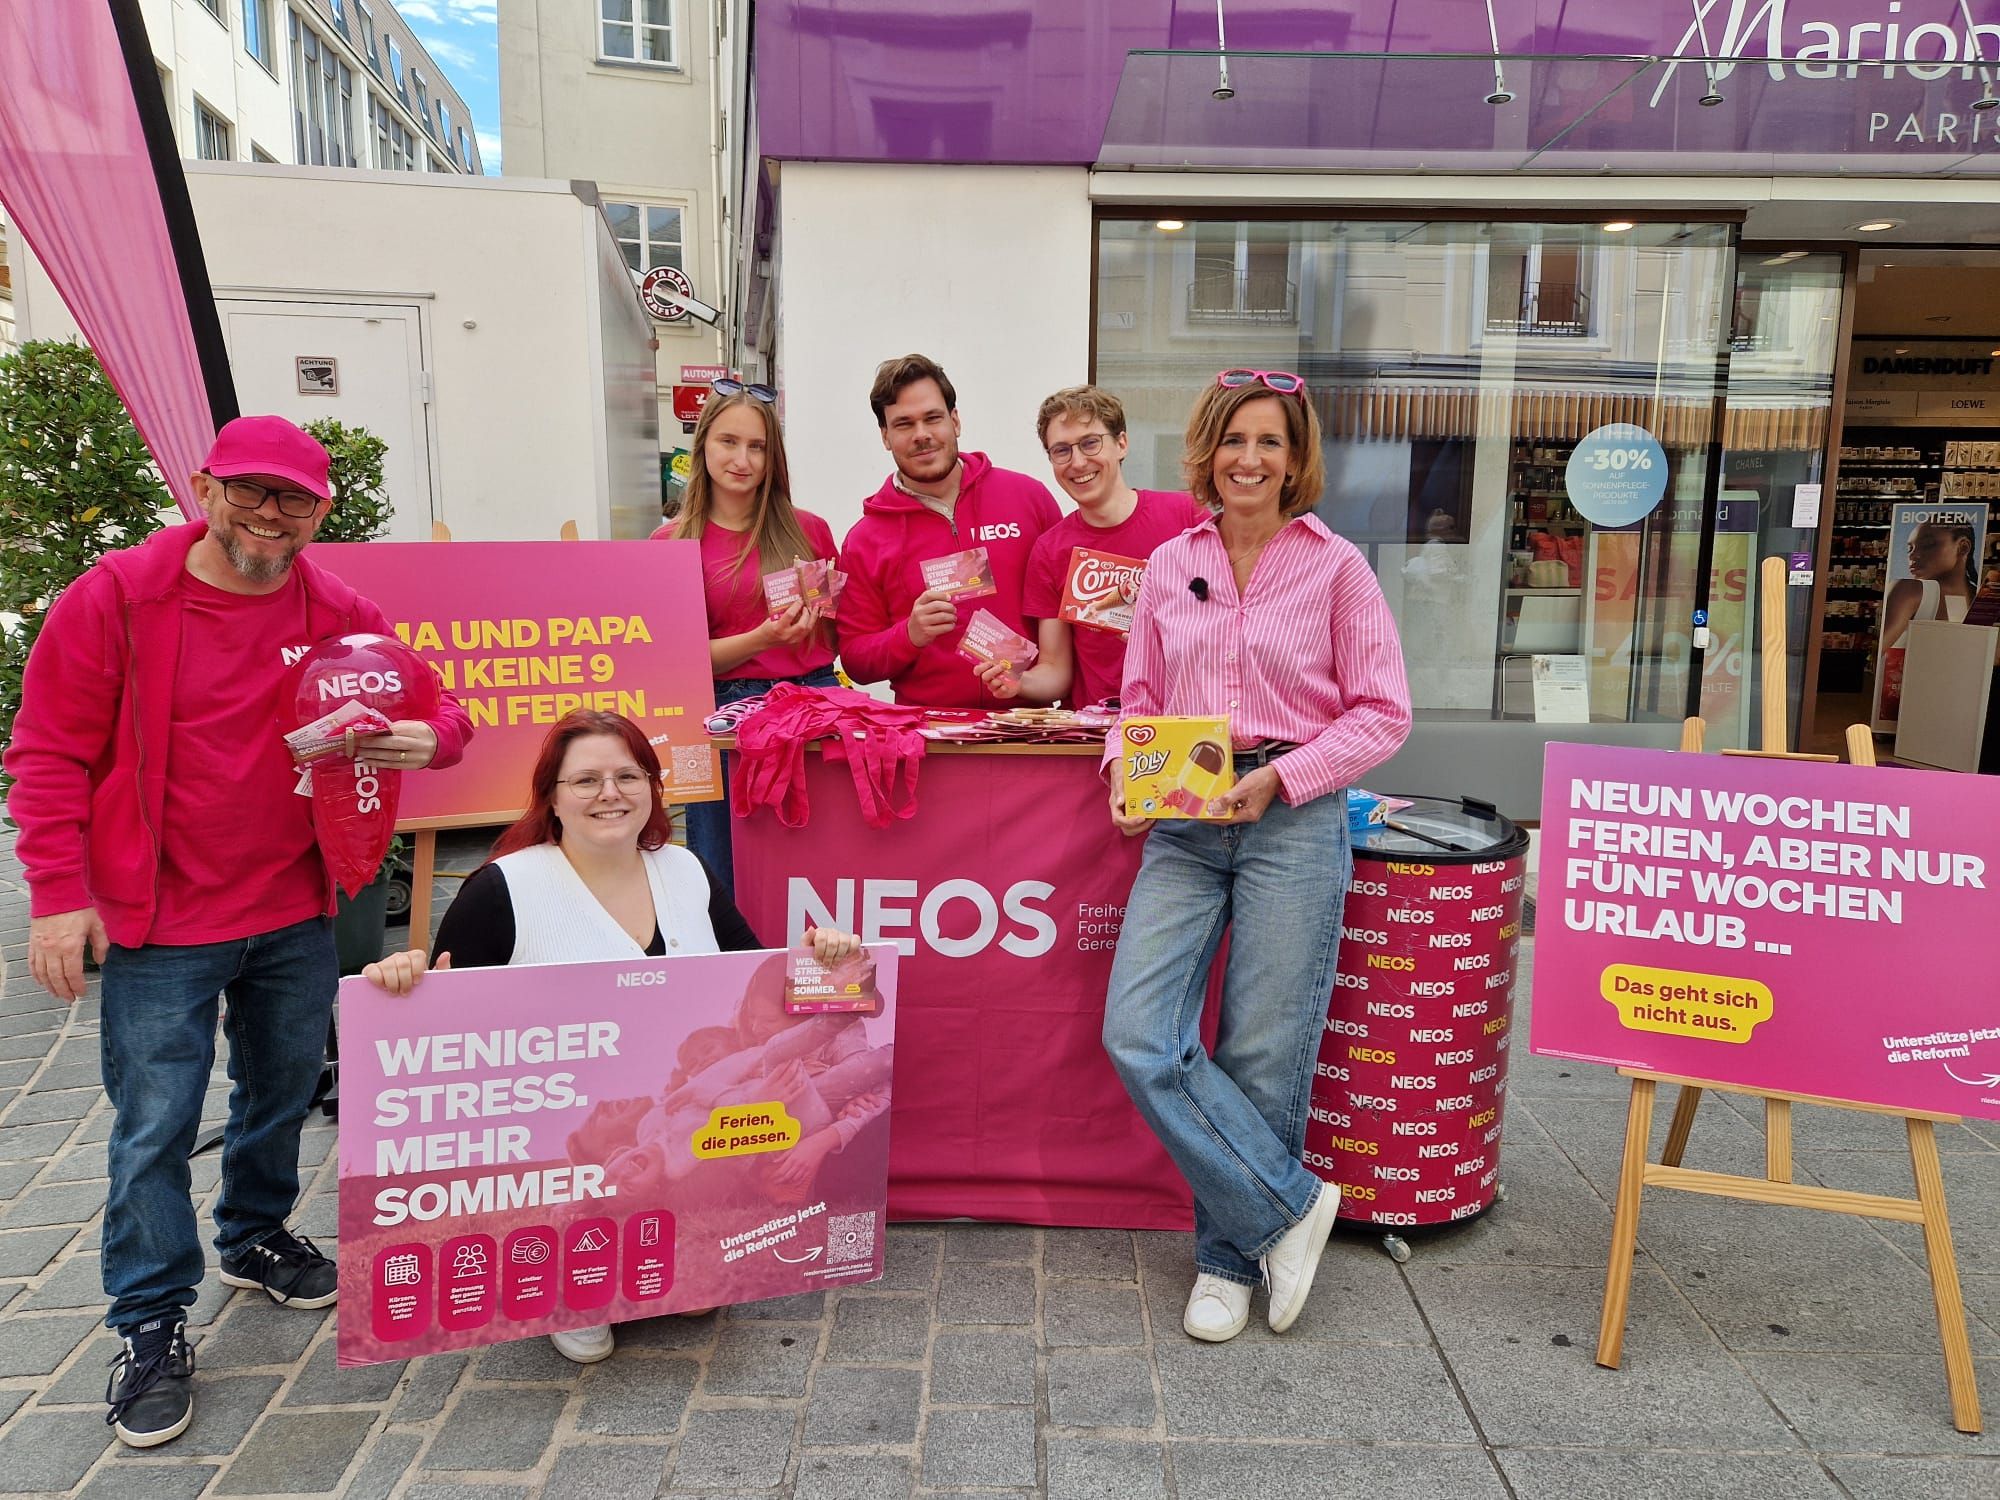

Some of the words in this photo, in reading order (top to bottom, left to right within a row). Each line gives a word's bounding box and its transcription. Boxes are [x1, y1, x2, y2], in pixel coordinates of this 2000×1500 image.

[651, 270, 689, 294] TABAK
[643, 288, 679, 315] TRAFIK
[683, 369, 726, 378] AUTOMAT
[1864, 357, 1994, 375] DAMENDUFT
[1951, 400, 1986, 409] LOEWE
[1584, 449, 1652, 470] -30%
[1735, 458, 1764, 470] CHANEL
[1609, 472, 1626, 480] AUF
[1593, 491, 1639, 499] PRODUKTE
[1901, 511, 1978, 524] BIOTHERM
[929, 577, 949, 587] MEHR
[451, 619, 541, 650] UND
[548, 615, 653, 647] PAPA
[464, 654, 584, 689] KEINE
[589, 653, 615, 683] 9
[318, 671, 402, 701] NEOS
[507, 689, 646, 727] FERIEN
[648, 733, 669, 746] etzt
[353, 756, 381, 814] EOS
[1569, 778, 1693, 820] NEUN
[1700, 788, 1911, 839] WOCHEN
[1567, 817, 1736, 871] FERIEN,
[1743, 834, 1872, 879] ABER
[1881, 847, 1986, 889] NUR
[1387, 862, 1435, 876] NEOS
[1472, 861, 1505, 875] NEOS
[1429, 886, 1473, 900] NEOS
[1501, 874, 1522, 894] NEOS
[1565, 854, 1681, 899] FÜNF
[1690, 871, 1903, 924] WOCHEN
[788, 877, 1057, 958] NEOS
[1078, 903, 1126, 918] Freihe
[1387, 908, 1435, 924] NEOS
[1471, 904, 1504, 922] NEOS
[1499, 920, 1519, 940] NEOS
[1563, 898, 1747, 950] URLAUB
[1077, 937, 1116, 951] Gere
[1342, 926, 1388, 945] NEOS
[1429, 933, 1472, 948] NEOS
[1367, 954, 1415, 972] NEOS
[1453, 954, 1490, 971] NEOS
[616, 970, 667, 988] NEOS
[794, 976, 821, 985] MEHR
[1335, 973, 1369, 990] EOS
[1485, 969, 1510, 990] NEOS
[793, 985, 837, 995] SOMMER.
[1410, 982, 1455, 996] NEOS
[1614, 975, 1655, 997] Das
[1658, 982, 1709, 1004] geht
[1713, 988, 1759, 1010] sich
[1367, 1002, 1415, 1018] NEOS
[1452, 1001, 1488, 1018] NEOS
[1633, 1003, 1687, 1026] nicht
[1691, 1010, 1738, 1032] aus.
[1324, 1018, 1369, 1038] NEOS
[1483, 1015, 1507, 1036] NEOS
[1410, 1029, 1454, 1043] NEOS
[1882, 1031, 1969, 1049] Unterstütze
[374, 1020, 621, 1077] WENIGER
[1348, 1046, 1396, 1065] NEOS
[1435, 1049, 1474, 1066] NEOS
[1887, 1051, 1911, 1063] die
[1911, 1044, 1971, 1061] Reform!
[1391, 1075, 1436, 1089] NEOS
[1469, 1064, 1497, 1084] NEOS
[373, 1072, 588, 1128] STRESS.
[1350, 1093, 1397, 1112] NEOS
[1436, 1095, 1473, 1112] NEOS
[720, 1111, 776, 1132] Ferien,
[1308, 1106, 1351, 1128] NEOS
[1469, 1107, 1495, 1129] NEOS
[1393, 1122, 1437, 1136] NEOS
[701, 1135, 727, 1153] die
[730, 1128, 791, 1151] passen.
[1332, 1136, 1379, 1156] NEOS
[376, 1125, 531, 1179] MEHR
[1419, 1142, 1459, 1159] NEOS
[1303, 1151, 1334, 1170] EOS
[1455, 1156, 1485, 1176] NEOS
[1374, 1166, 1420, 1181] NEOS
[1480, 1165, 1498, 1189] NEOS
[372, 1163, 618, 1228] SOMMER.
[1416, 1187, 1456, 1203] NEOS
[1372, 1211, 1417, 1226] NEOS
[1451, 1200, 1481, 1220] NEOS
[720, 1213, 797, 1251] Unterstütze
[797, 1201, 827, 1223] jetzt
[723, 1248, 745, 1263] die
[745, 1225, 798, 1255] Reform!
[452, 1305, 482, 1316] ganztägig
